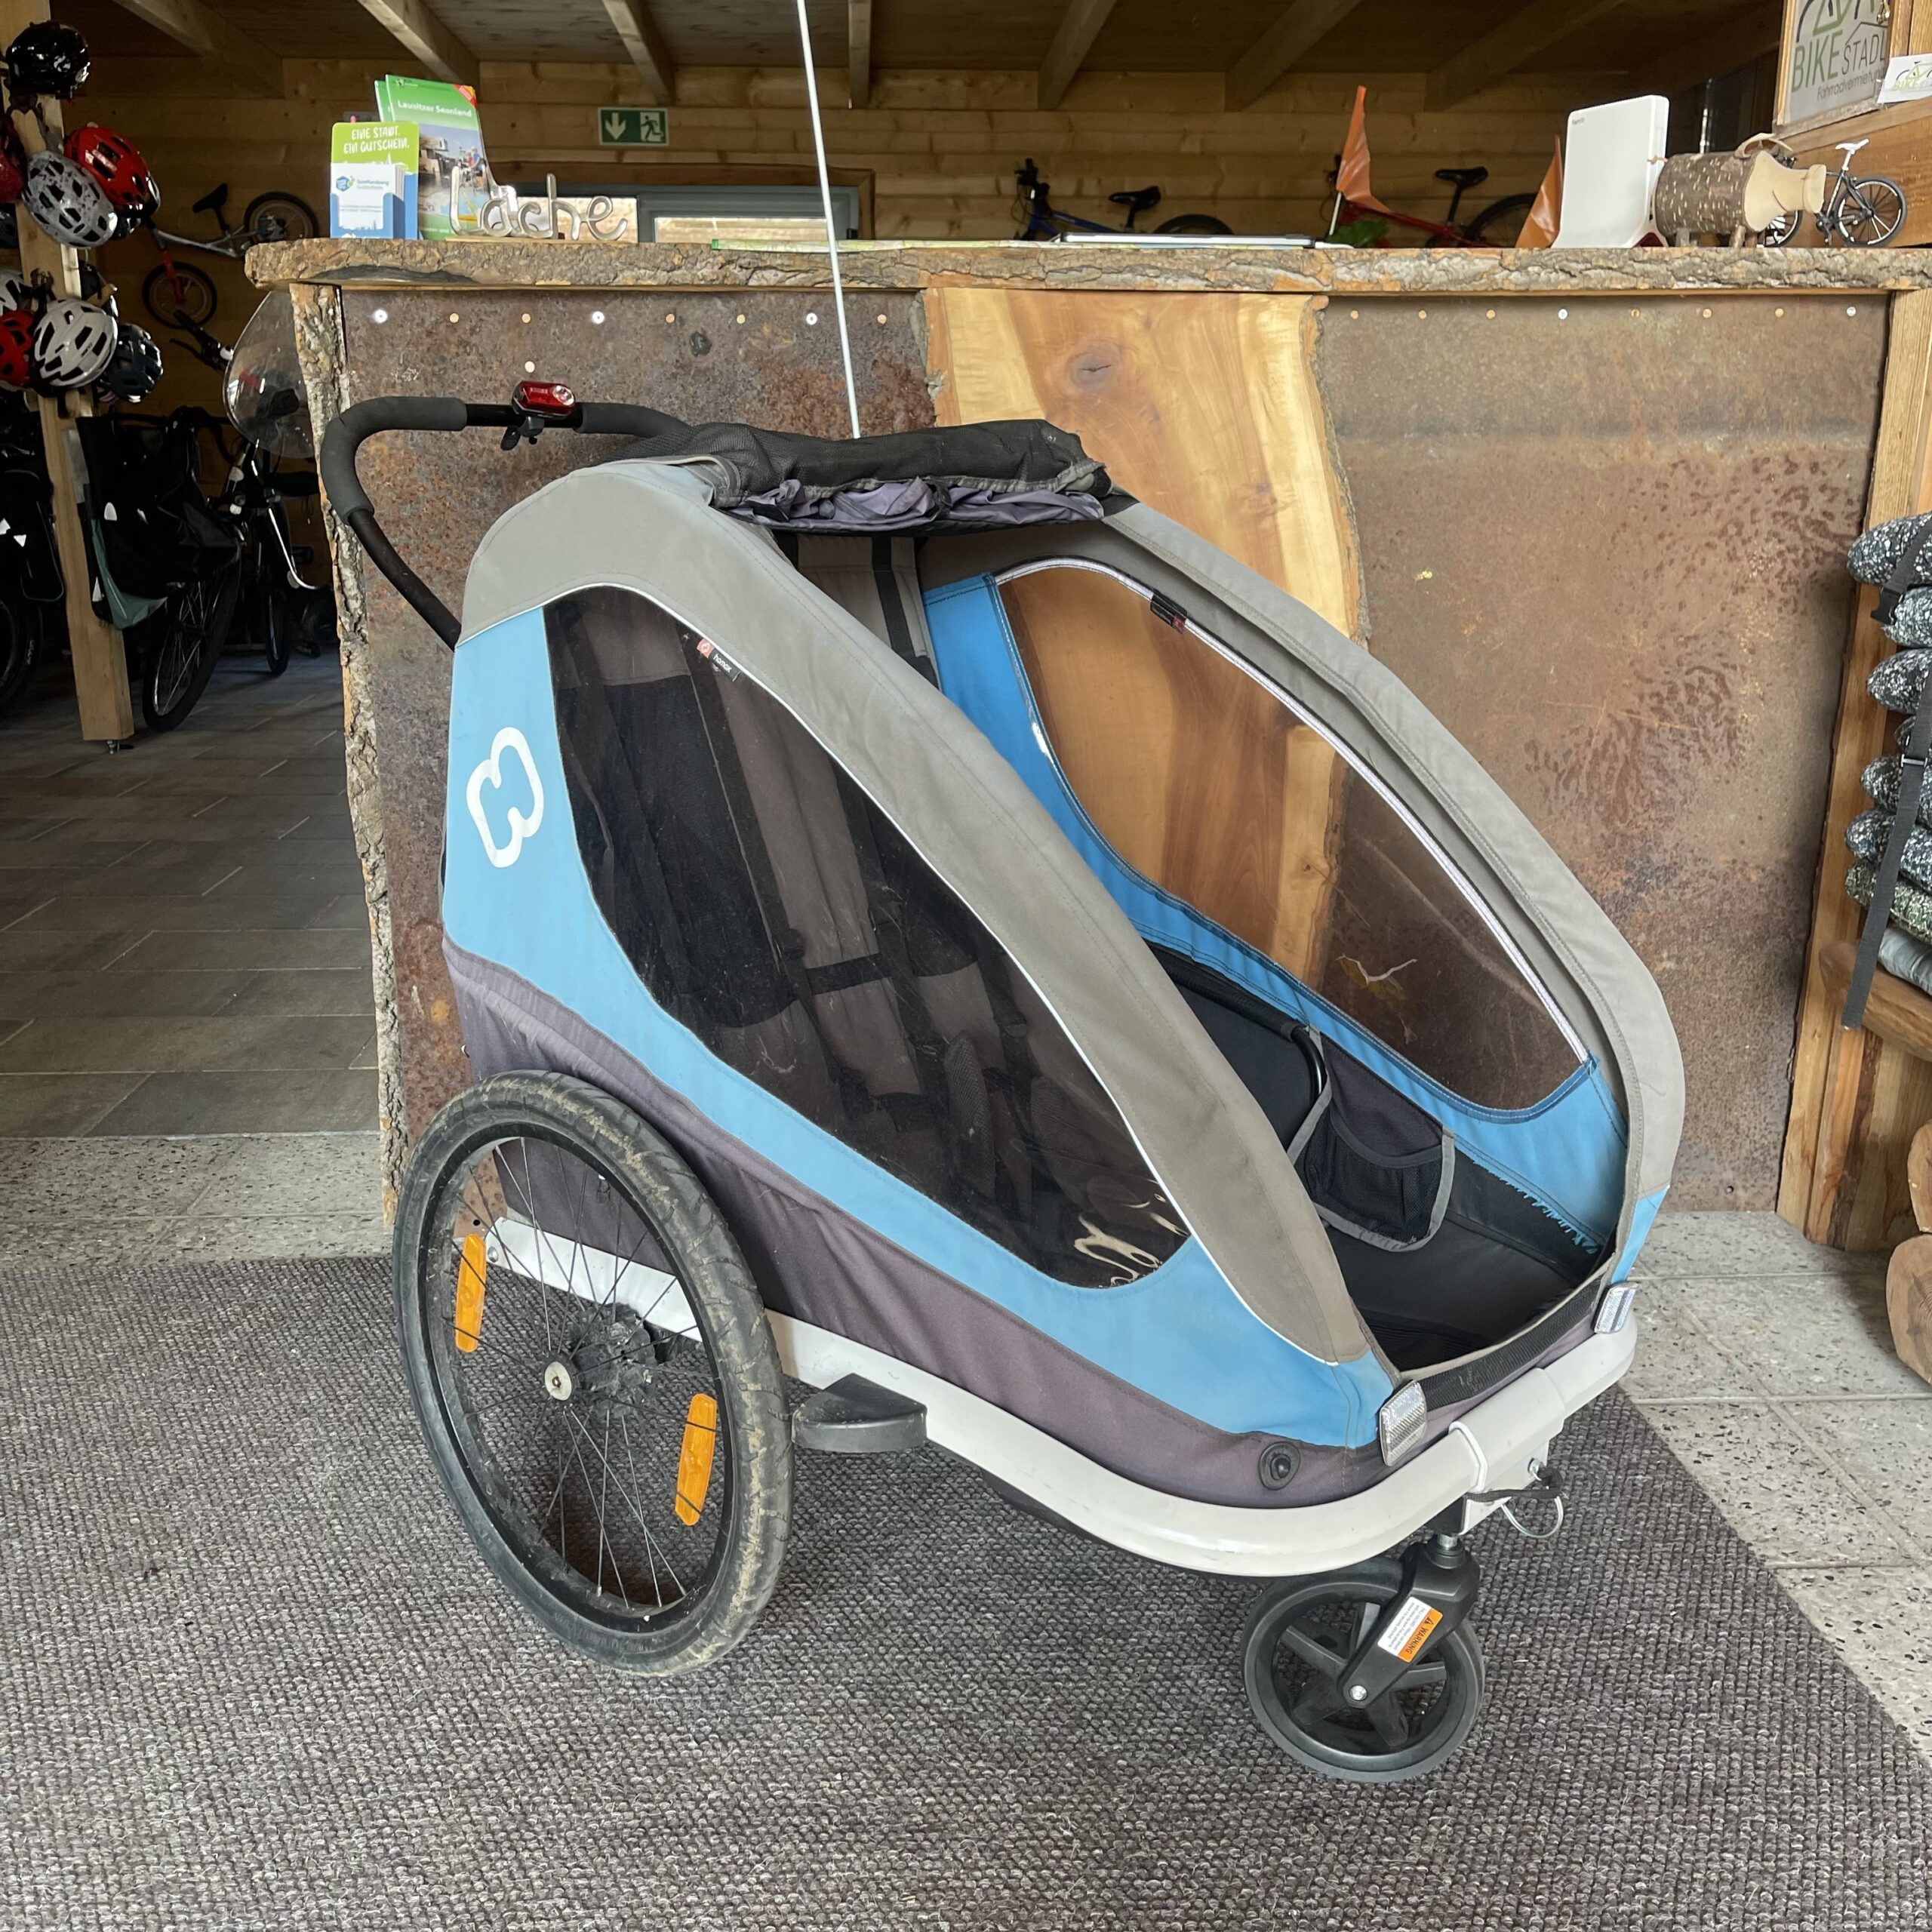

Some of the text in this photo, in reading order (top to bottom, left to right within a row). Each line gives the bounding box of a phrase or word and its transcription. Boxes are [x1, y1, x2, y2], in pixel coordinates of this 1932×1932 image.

[1792, 29, 1843, 93] BIKE
[397, 100, 472, 118] Lausitzer Seenland
[351, 125, 401, 140] EINE STADT.
[343, 137, 410, 155] EIN GUTSCHEIN.
[712, 653, 733, 673] hamax
[1404, 1626, 1429, 1654] WARNING
